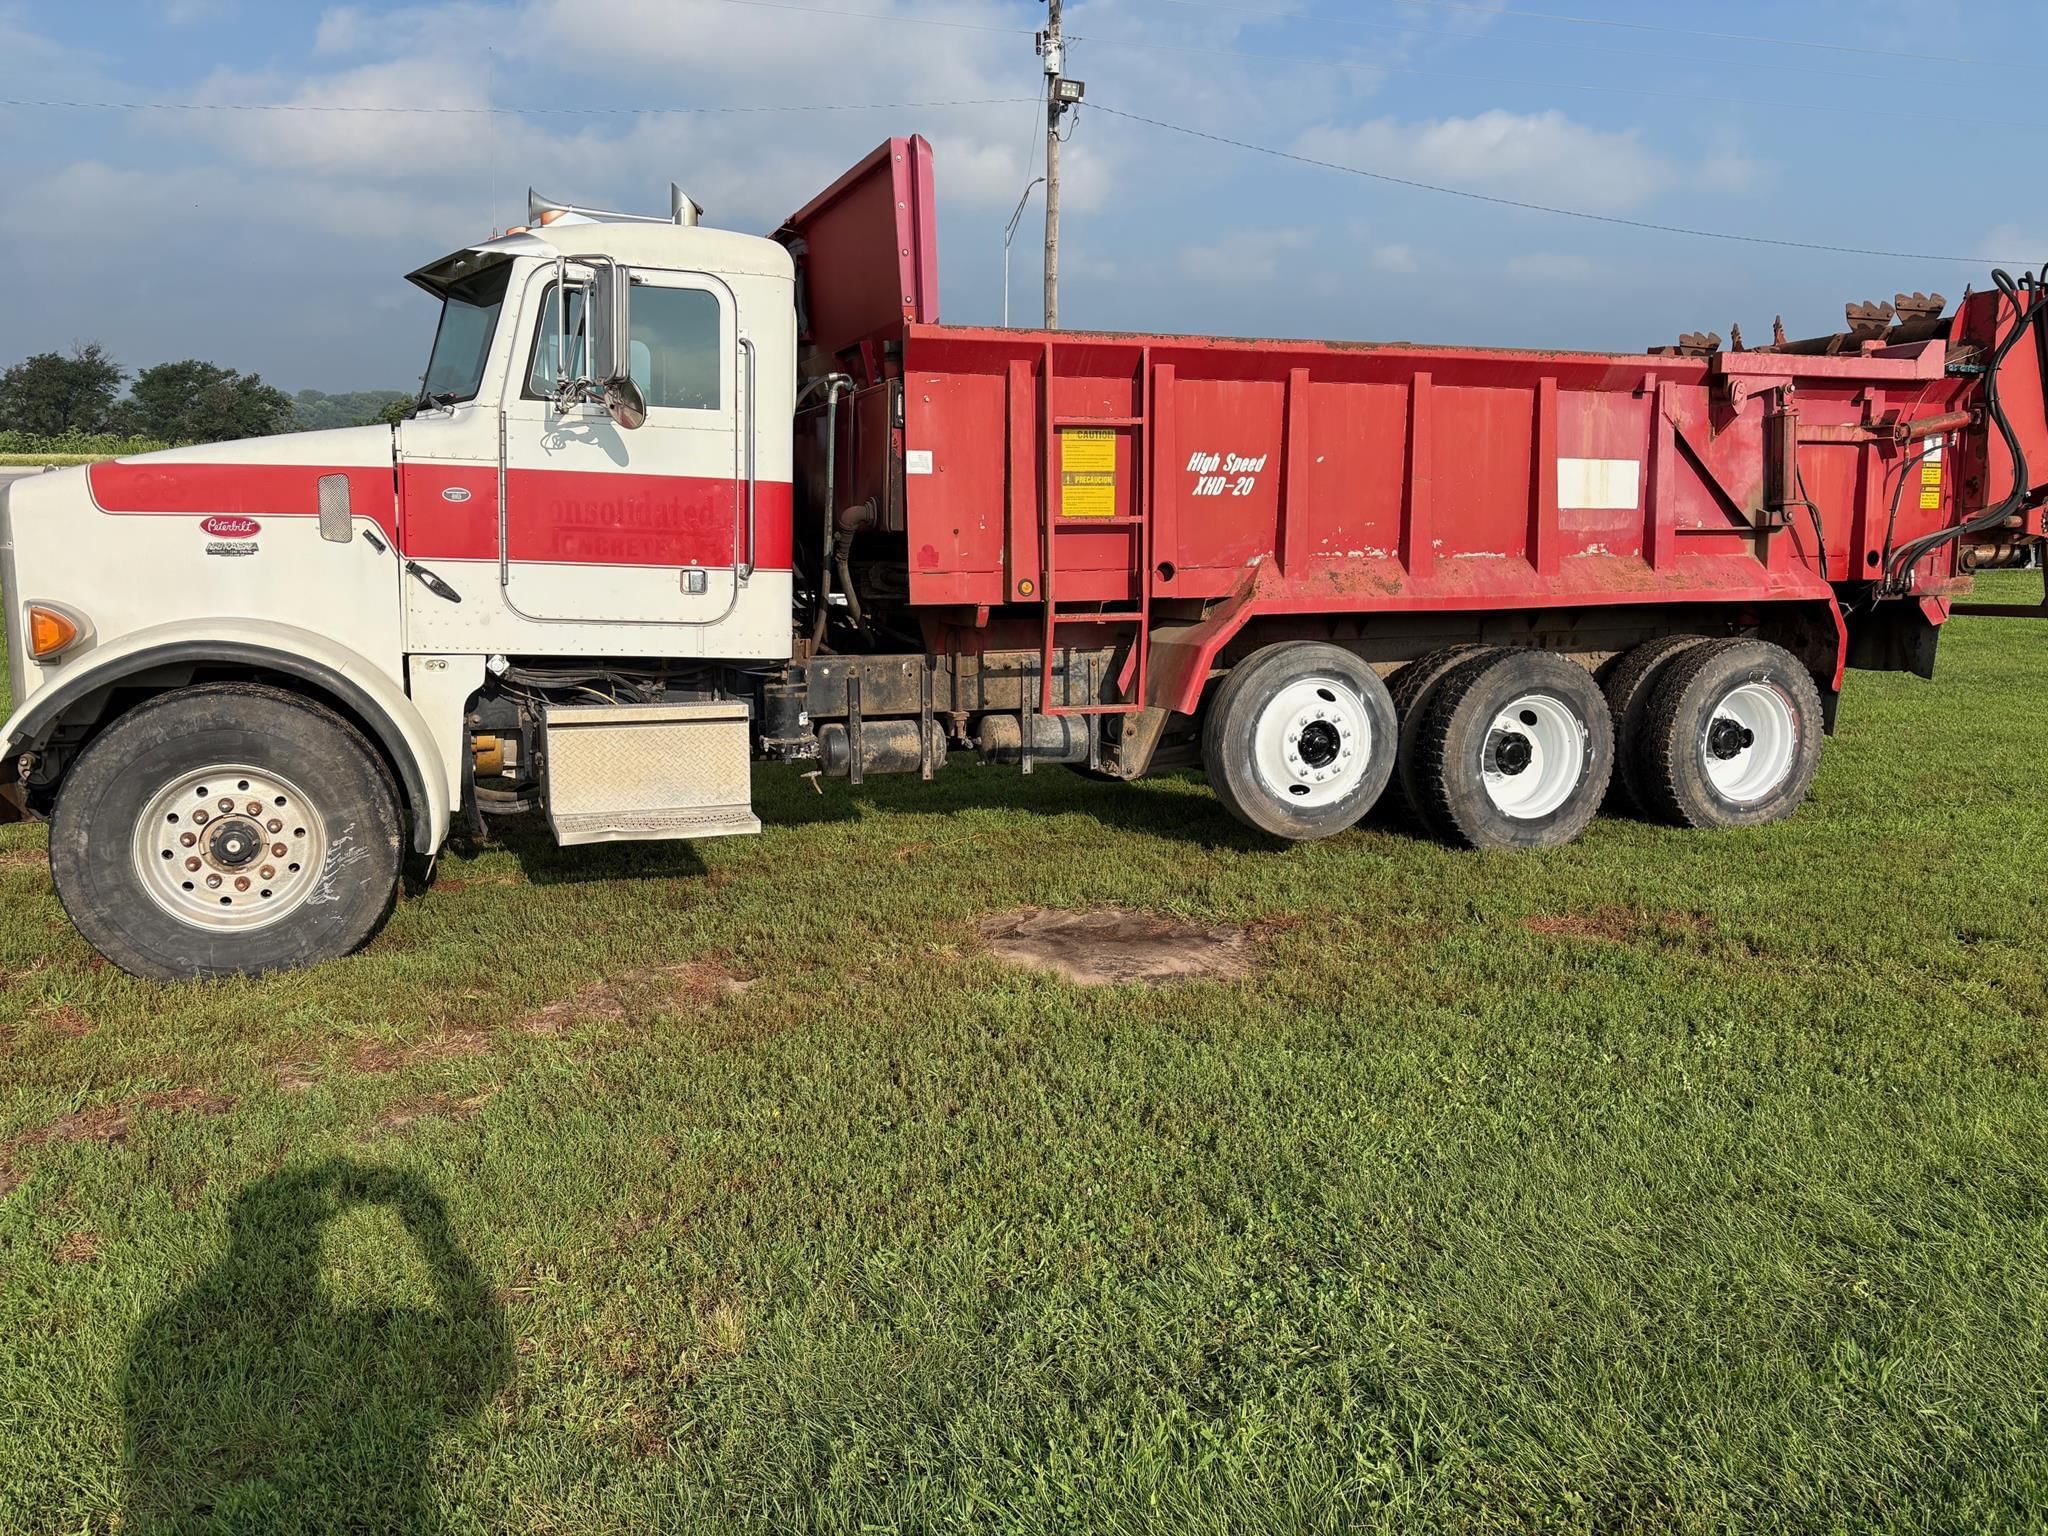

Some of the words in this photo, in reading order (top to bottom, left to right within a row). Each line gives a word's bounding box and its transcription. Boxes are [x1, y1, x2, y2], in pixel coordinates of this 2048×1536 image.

[1077, 430, 1114, 440] CAUTION
[1186, 452, 1220, 475] High
[1222, 452, 1267, 475] Speed
[1191, 476, 1255, 496] XHD-20
[207, 518, 256, 532] Peterbilt
